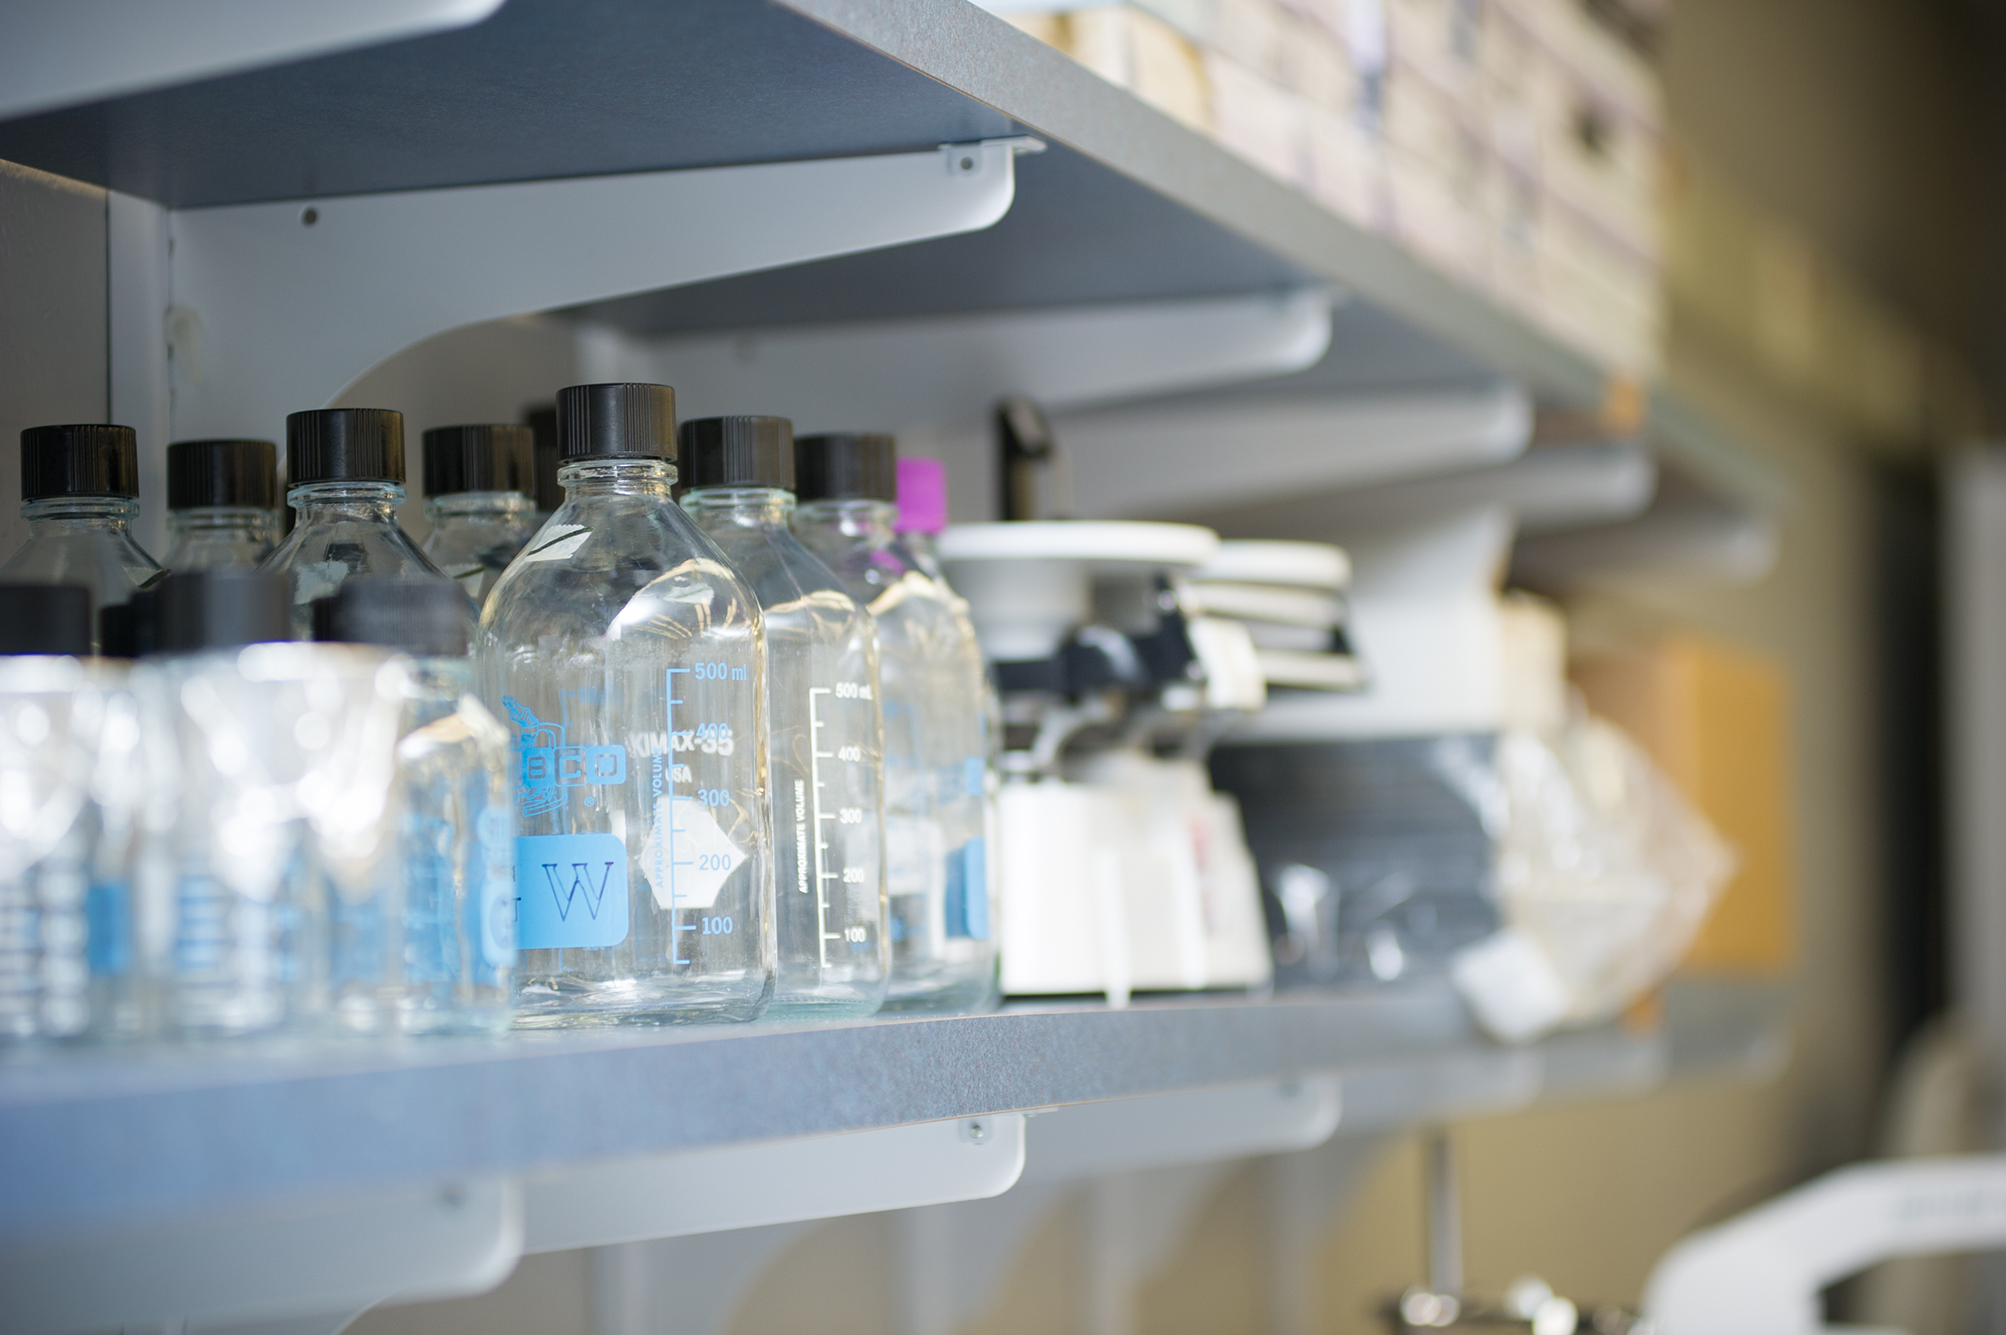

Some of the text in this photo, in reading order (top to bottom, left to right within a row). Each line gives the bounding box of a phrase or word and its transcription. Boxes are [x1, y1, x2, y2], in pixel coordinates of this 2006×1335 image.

[694, 662, 747, 681] 500 ml
[836, 682, 858, 698] 500
[696, 722, 729, 740] 400
[838, 746, 861, 762] 400
[698, 789, 730, 807] 300
[652, 747, 664, 889] APPROXIMATE VOLUME
[840, 809, 862, 825] 300
[795, 779, 808, 894] APPROXIMATE VOLUME
[699, 854, 731, 871] 200
[843, 868, 864, 884] 200
[702, 916, 733, 935] 100
[844, 927, 866, 943] 100
